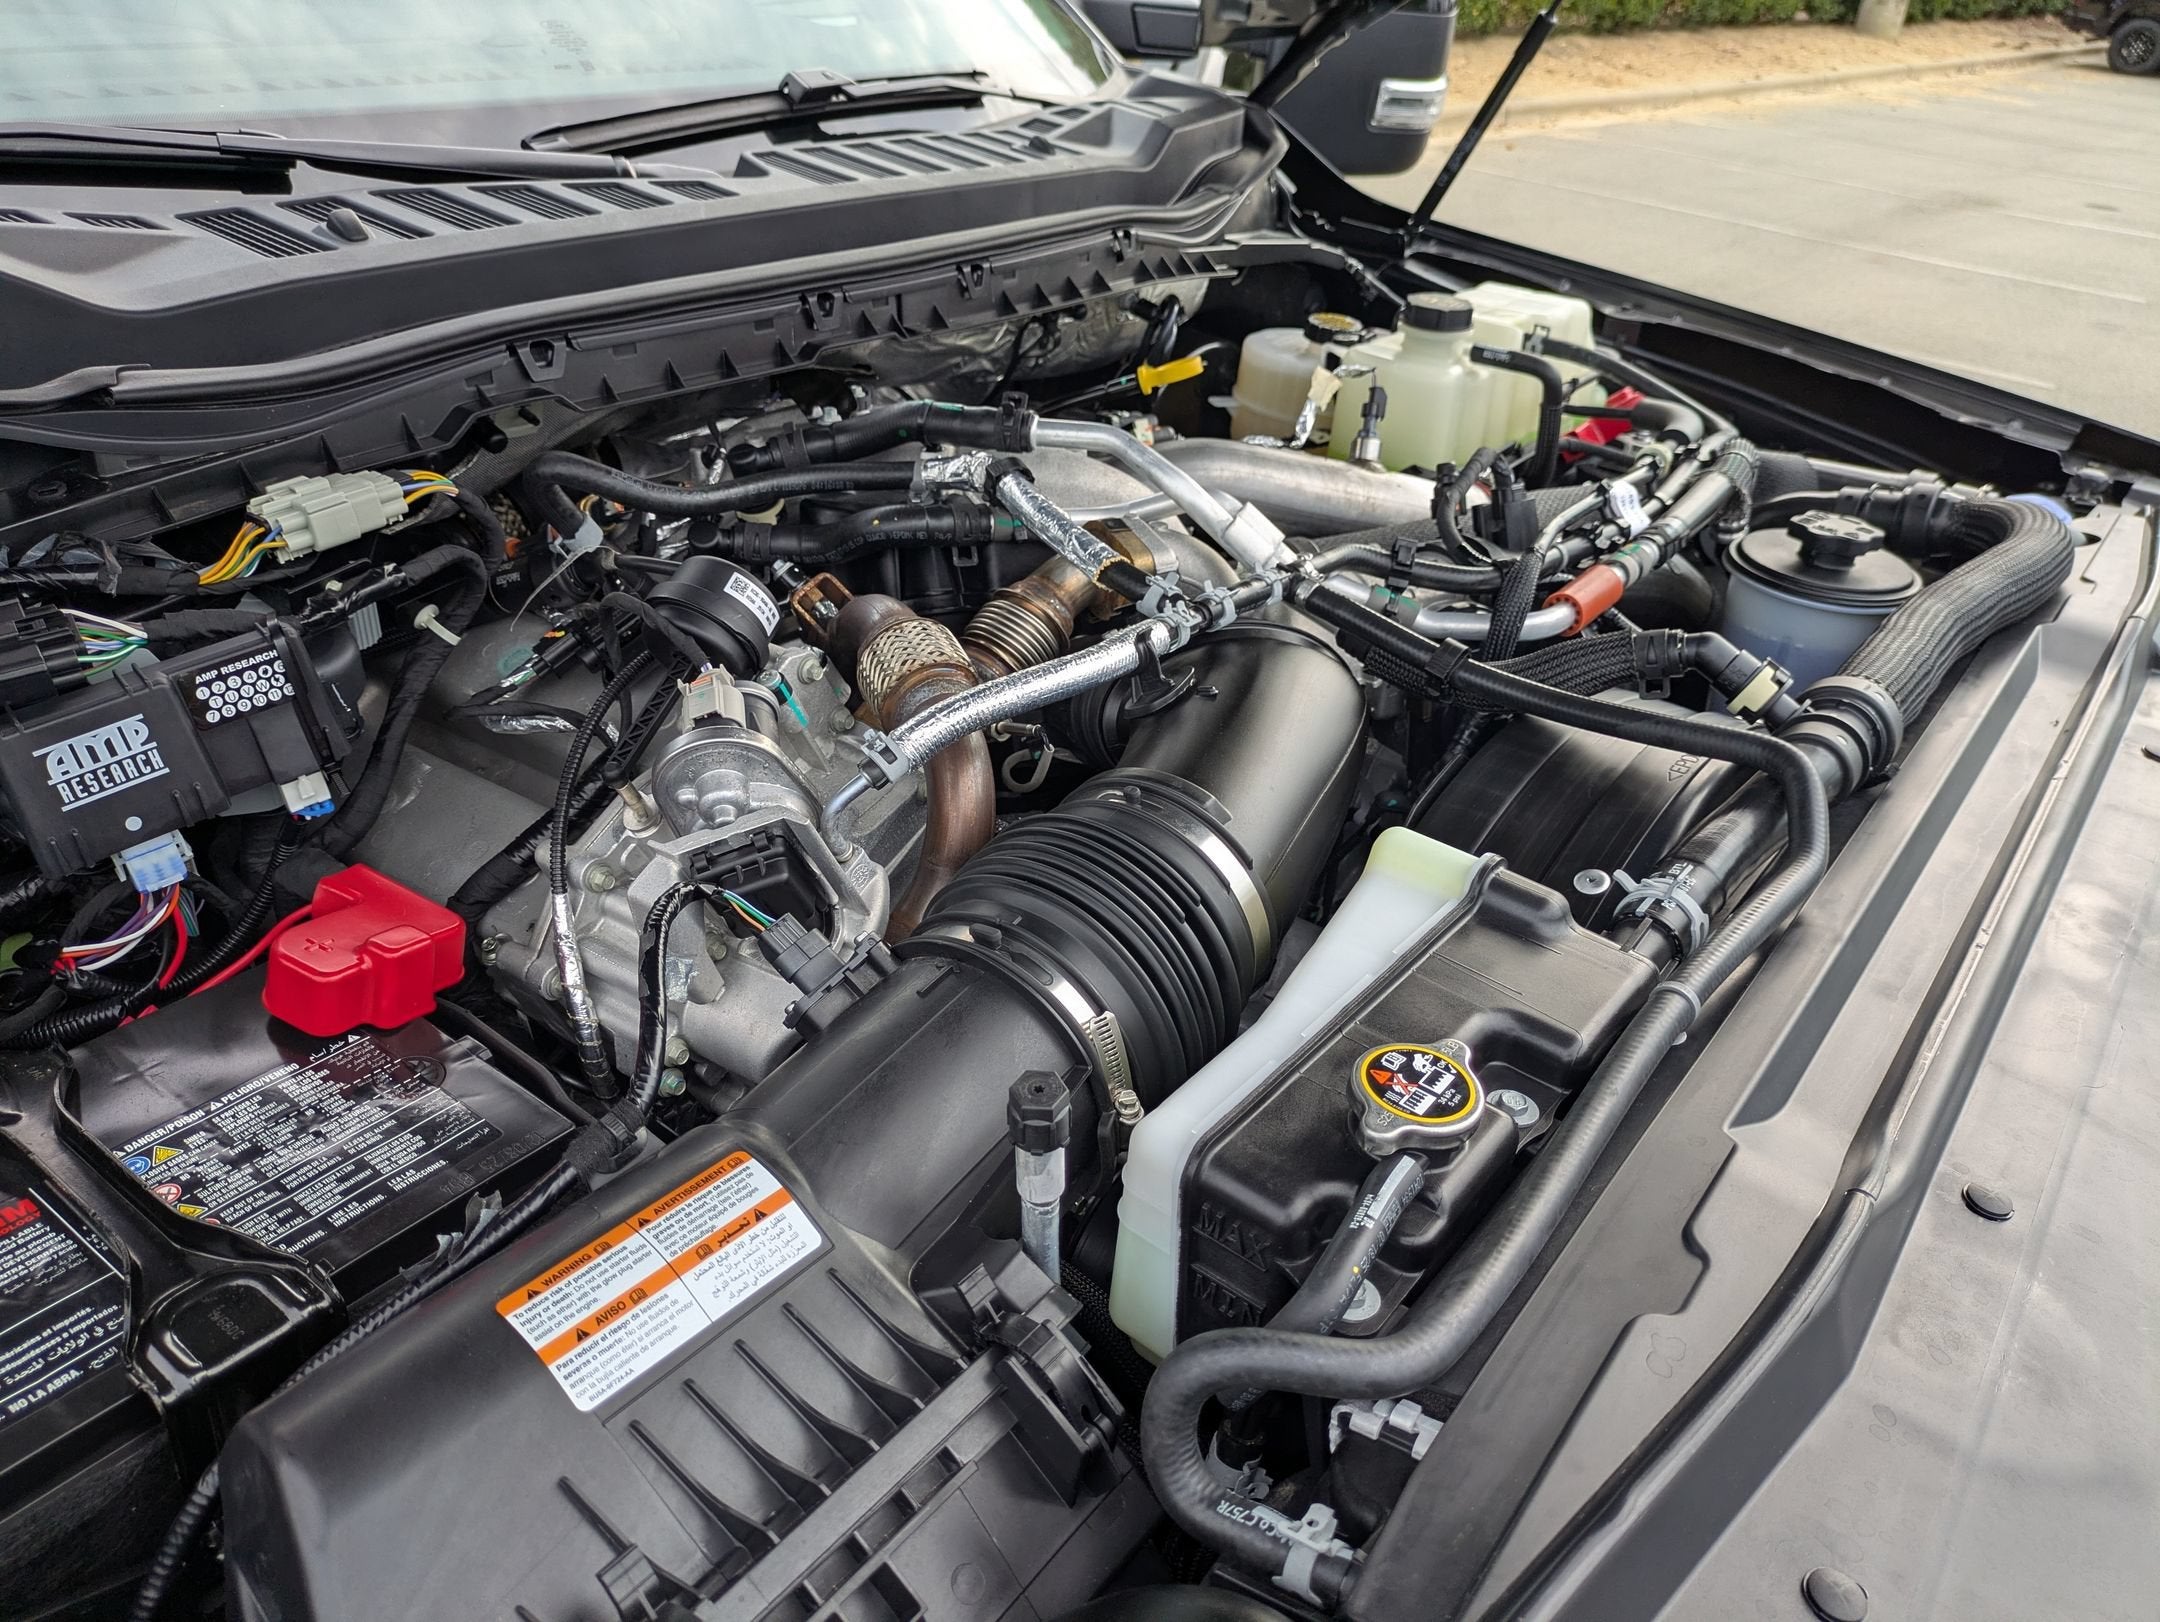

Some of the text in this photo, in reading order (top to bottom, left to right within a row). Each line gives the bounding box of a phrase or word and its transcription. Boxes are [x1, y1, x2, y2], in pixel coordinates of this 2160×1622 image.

[195, 649, 277, 684] AMP RESEARCH
[214, 682, 223, 693] 2
[230, 677, 239, 687] 3
[246, 672, 254, 680] 4
[224, 706, 233, 716] 8
[239, 700, 248, 710] 9
[253, 694, 265, 705] 10
[269, 689, 280, 699] 11
[226, 691, 236, 703] U
[242, 686, 250, 696] V
[255, 679, 268, 692] W
[35, 715, 153, 783] AMP
[57, 749, 163, 802] RESEARCH
[221, 1063, 299, 1103] PELIGRO/VENENO
[1444, 1088, 1456, 1098] kPa
[1454, 1094, 1462, 1104] psi
[124, 1109, 204, 1152] DANGER/POISON
[179, 1172, 191, 1181] NO
[196, 1172, 242, 1199] SULFURIC ACID
[386, 1168, 416, 1187] LEA LAS
[653, 1165, 726, 1215] AVERTISSEMENT
[219, 1190, 266, 1218] KEEP OUT OF THE
[243, 1204, 253, 1212] OF
[327, 1201, 359, 1223] LIRE LES
[644, 1221, 663, 1234] Pour
[662, 1206, 686, 1223] réduire
[692, 1189, 713, 1204] risque
[711, 1183, 722, 1191] de
[720, 1165, 751, 1186] blessures
[651, 1222, 675, 1240] graves
[674, 1216, 684, 1225] ou
[683, 1210, 693, 1219] de
[733, 1176, 746, 1187] pas
[744, 1171, 754, 1179] de
[656, 1229, 679, 1245] fluides
[677, 1223, 687, 1232] de
[686, 1203, 719, 1226] démarrage
[717, 1195, 732, 1206] (tels
[663, 1186, 759, 1251] avec ce moteur équipé de bougies
[668, 1224, 717, 1258] de préchauffage.
[1198, 1201, 1272, 1270] MAX
[512, 1245, 628, 1320] To reduce risk of possible serious
[541, 1253, 592, 1286] WARNING
[541, 1304, 551, 1313] or
[550, 1290, 574, 1307] death:
[572, 1283, 585, 1293] Do
[584, 1274, 597, 1286] not
[595, 1267, 609, 1278] use
[608, 1253, 629, 1270] starter
[628, 1243, 647, 1256] fluids
[526, 1249, 652, 1335] (such as ether) with the glow plug starter
[595, 1300, 626, 1326] AVISO
[533, 1296, 599, 1342] assist on the engine.
[555, 1293, 669, 1372] Para reducir el riesgo de lesiones
[562, 1358, 591, 1380] severas
[597, 1335, 624, 1357] muerte:
[624, 1327, 636, 1338] No
[635, 1319, 649, 1330] use
[647, 1304, 670, 1322] fluidos
[669, 1298, 679, 1307] de
[568, 1366, 600, 1389] arranque
[599, 1351, 621, 1369] (como
[643, 1318, 669, 1337] arranca
[667, 1311, 676, 1321] el
[674, 1299, 694, 1316] motor
[575, 1386, 590, 1399] con
[587, 1381, 597, 1389] la
[613, 1351, 640, 1372] caliente
[639, 1344, 650, 1354] de
[649, 1324, 678, 1347] arranque.
[7, 1369, 84, 1413] NO LA ABRA.
[1216, 1500, 1258, 1526] C757R
